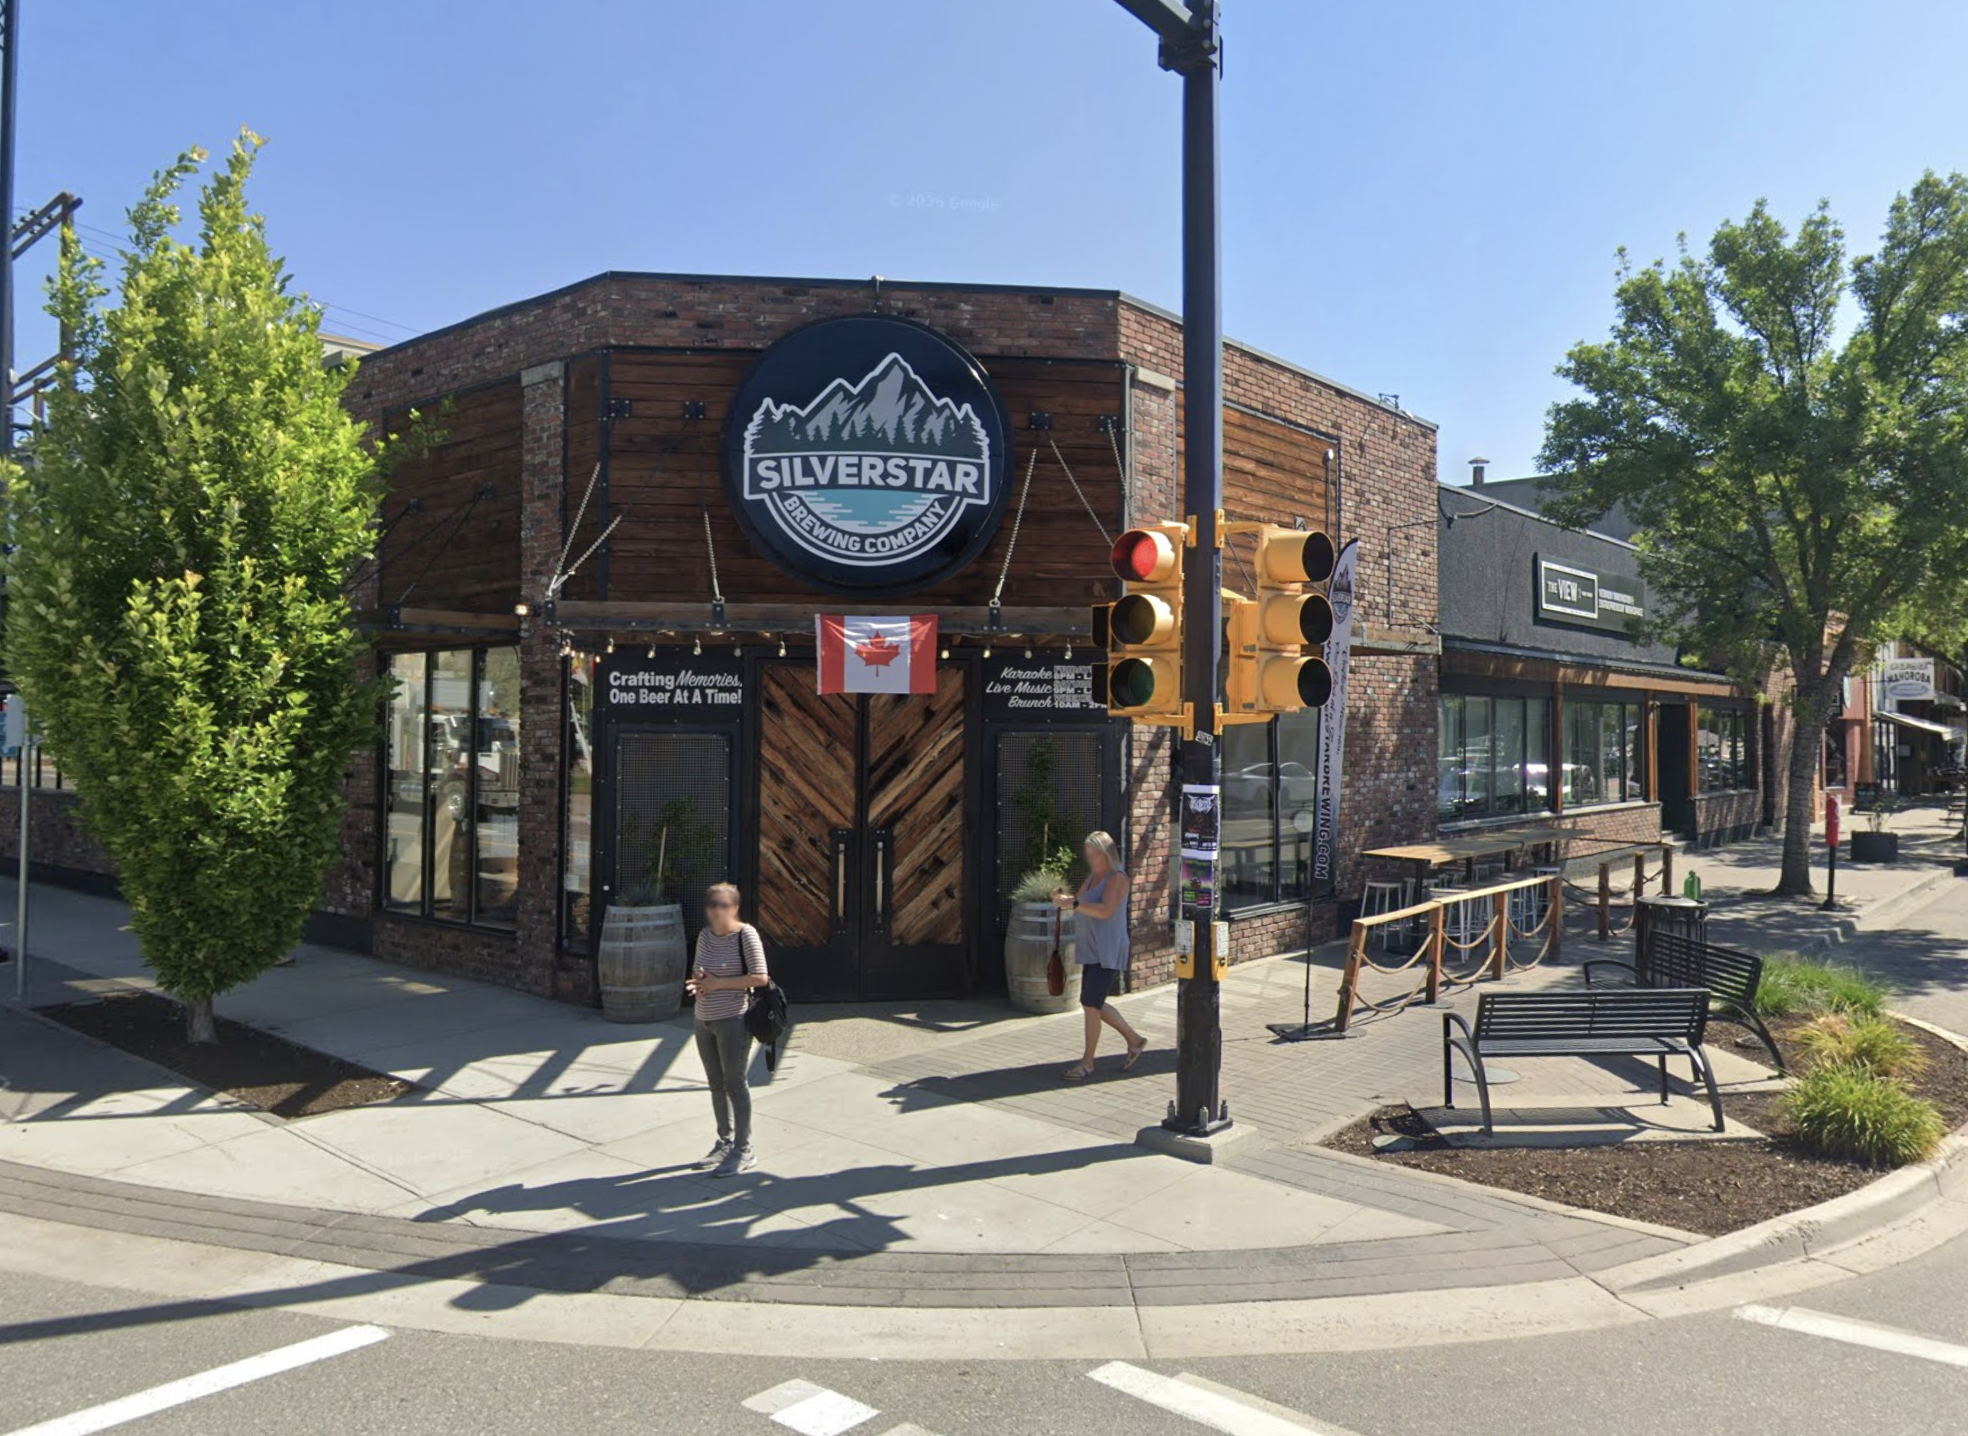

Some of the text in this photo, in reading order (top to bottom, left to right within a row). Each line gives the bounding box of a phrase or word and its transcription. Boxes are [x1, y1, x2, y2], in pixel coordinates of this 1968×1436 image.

[756, 455, 979, 494] SILVERSTAR
[783, 495, 948, 553] BREWING COMPANY
[1557, 578, 1578, 603] VIEW
[609, 670, 743, 690] Crafting Memories,
[1000, 666, 1053, 680] Karaoke
[985, 681, 1053, 694] Live Music
[609, 689, 742, 704] One Beer At A Time!
[1007, 695, 1053, 708] Brunch
